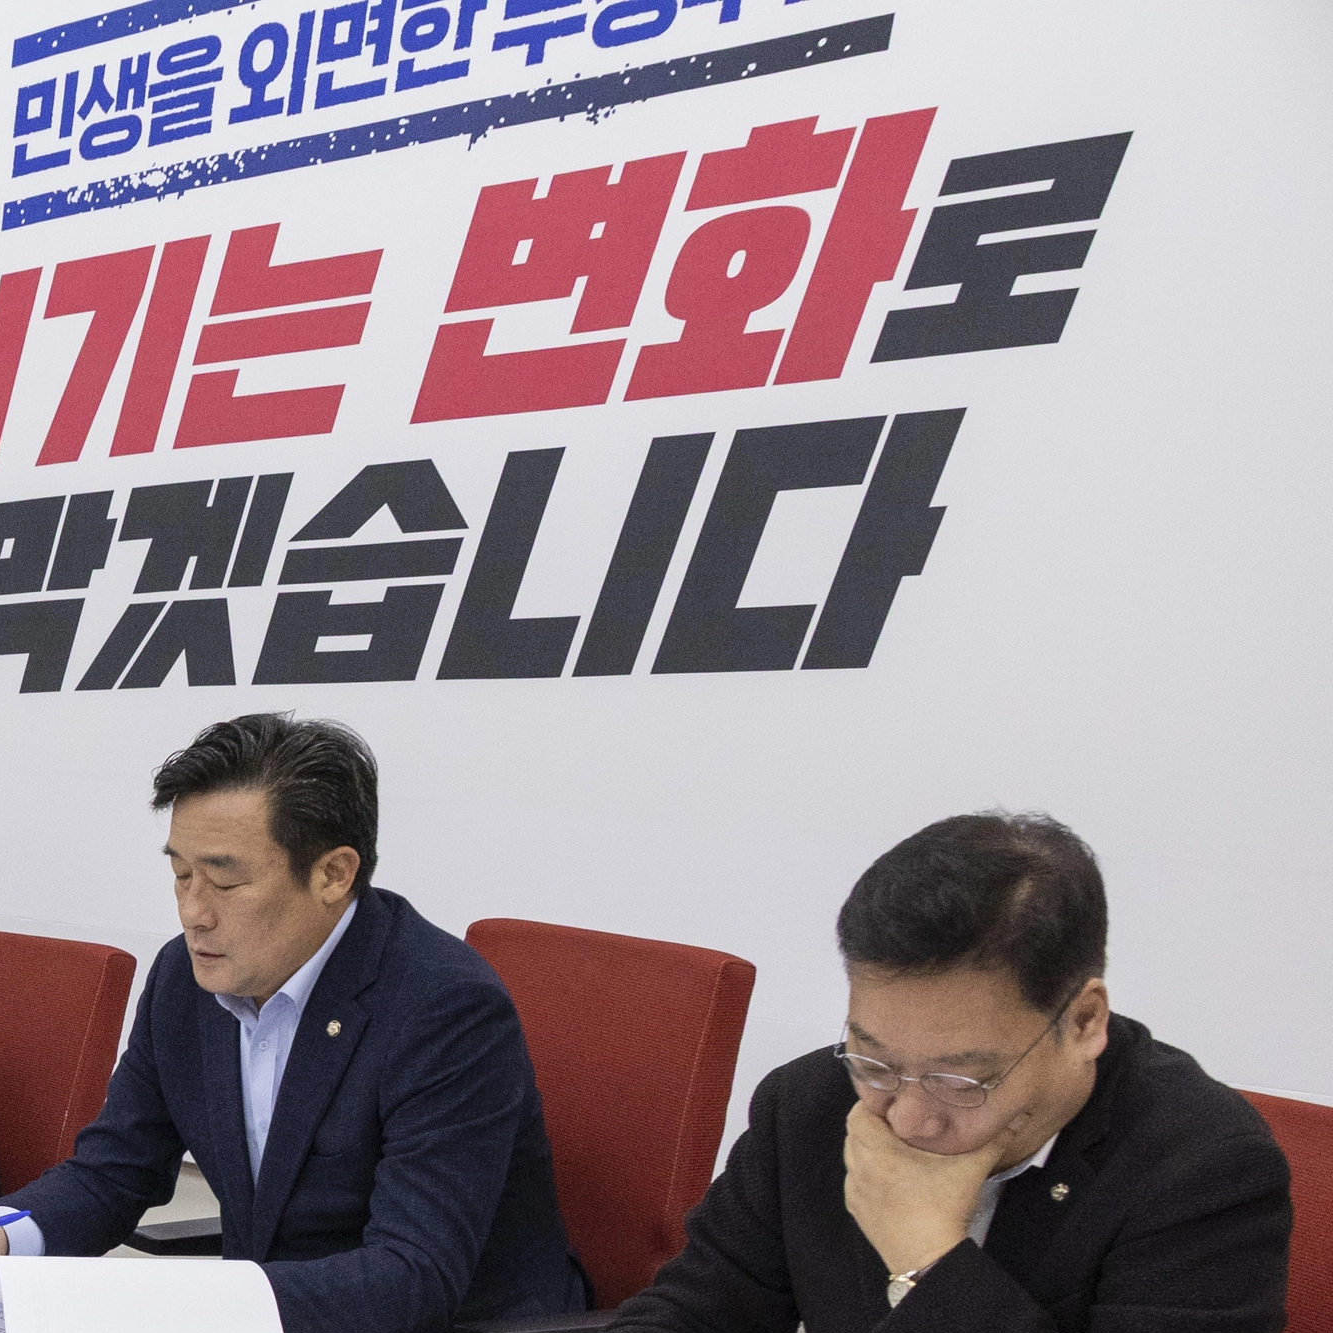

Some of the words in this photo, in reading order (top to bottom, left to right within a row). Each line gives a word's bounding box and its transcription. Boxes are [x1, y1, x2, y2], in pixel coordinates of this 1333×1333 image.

[12, 36, 223, 178] 민생을
[228, 0, 487, 126] 외면한
[410, 107, 1133, 423] 변화로
